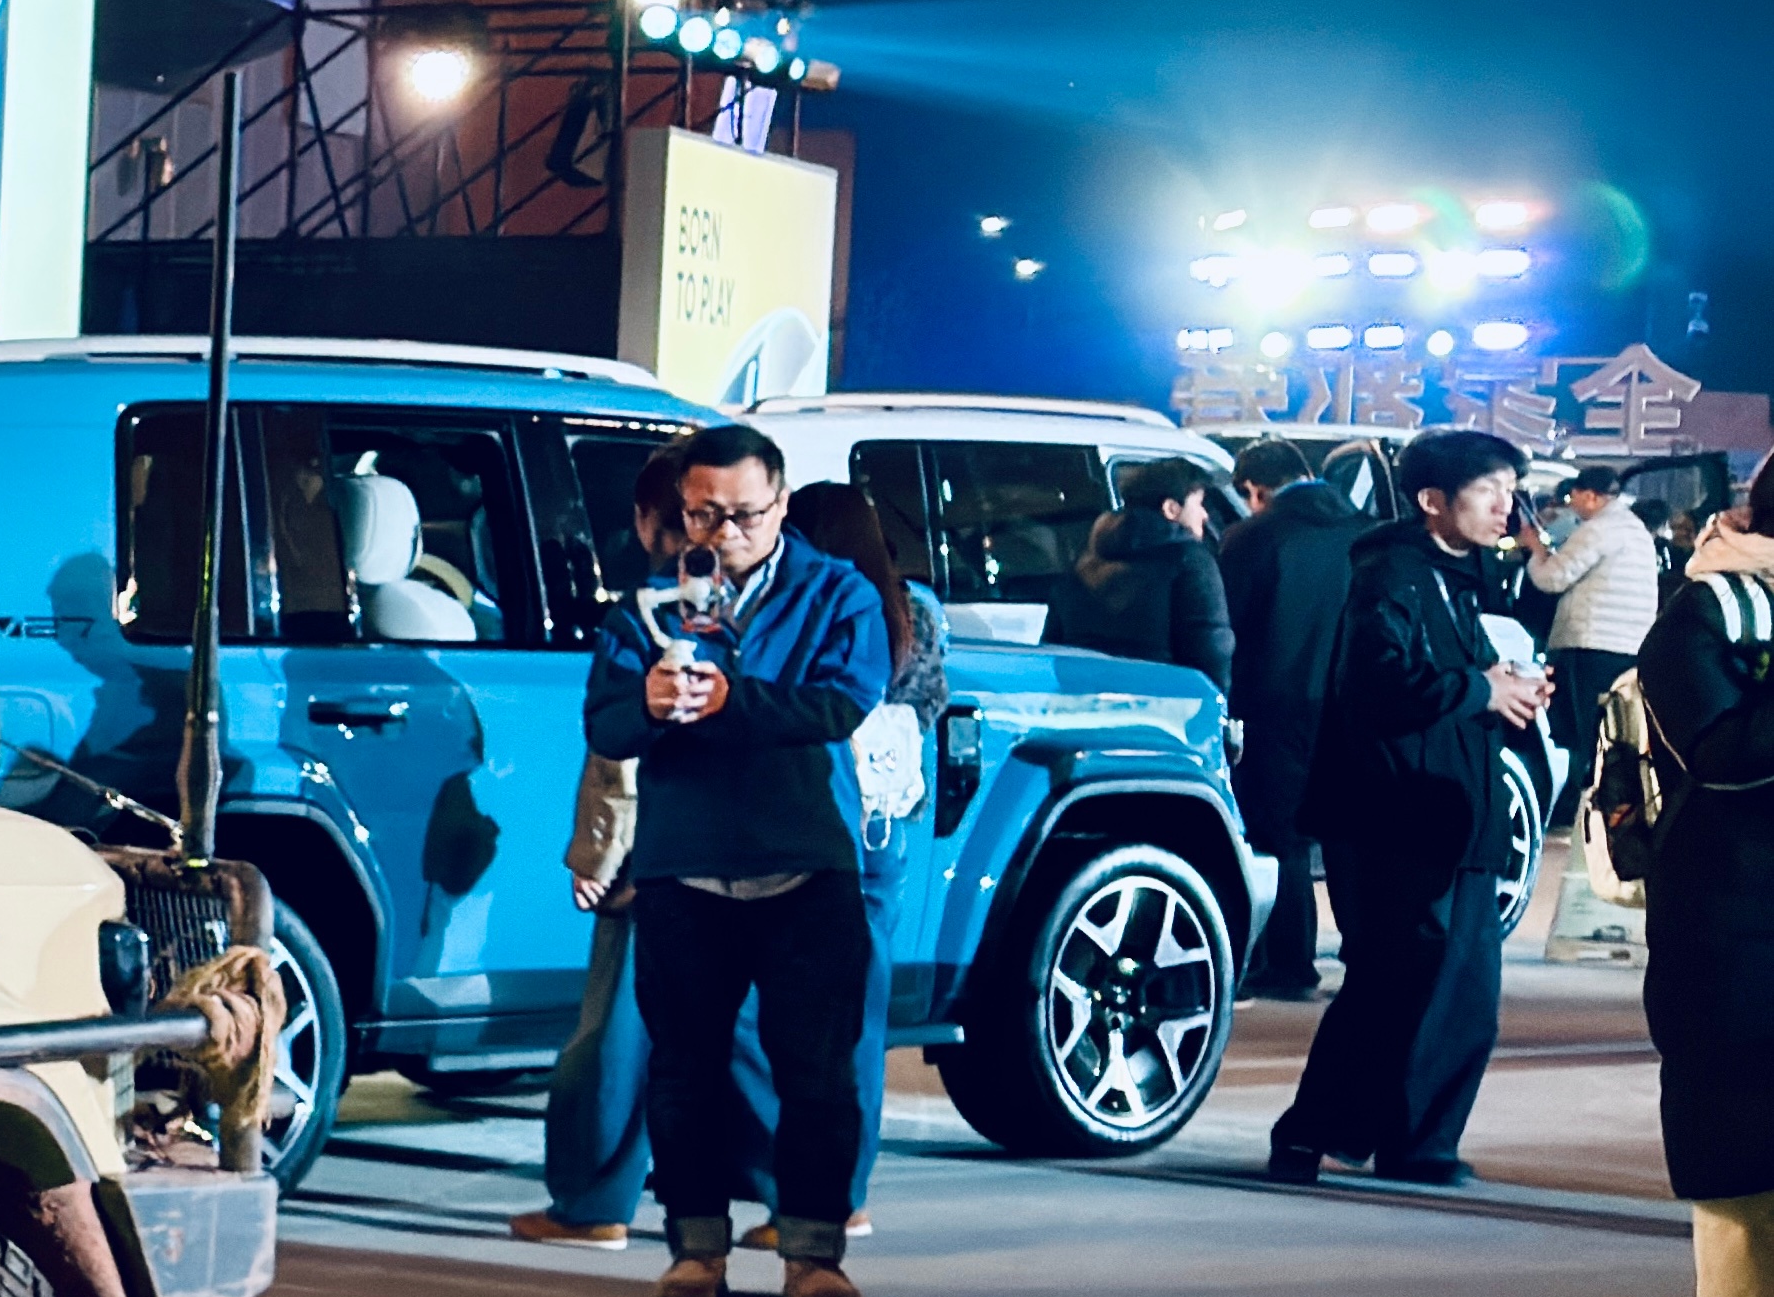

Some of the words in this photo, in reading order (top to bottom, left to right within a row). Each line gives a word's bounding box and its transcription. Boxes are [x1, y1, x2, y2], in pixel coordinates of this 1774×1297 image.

[679, 205, 722, 262] BORN
[676, 271, 696, 323] TO
[701, 273, 735, 328] PLAY
